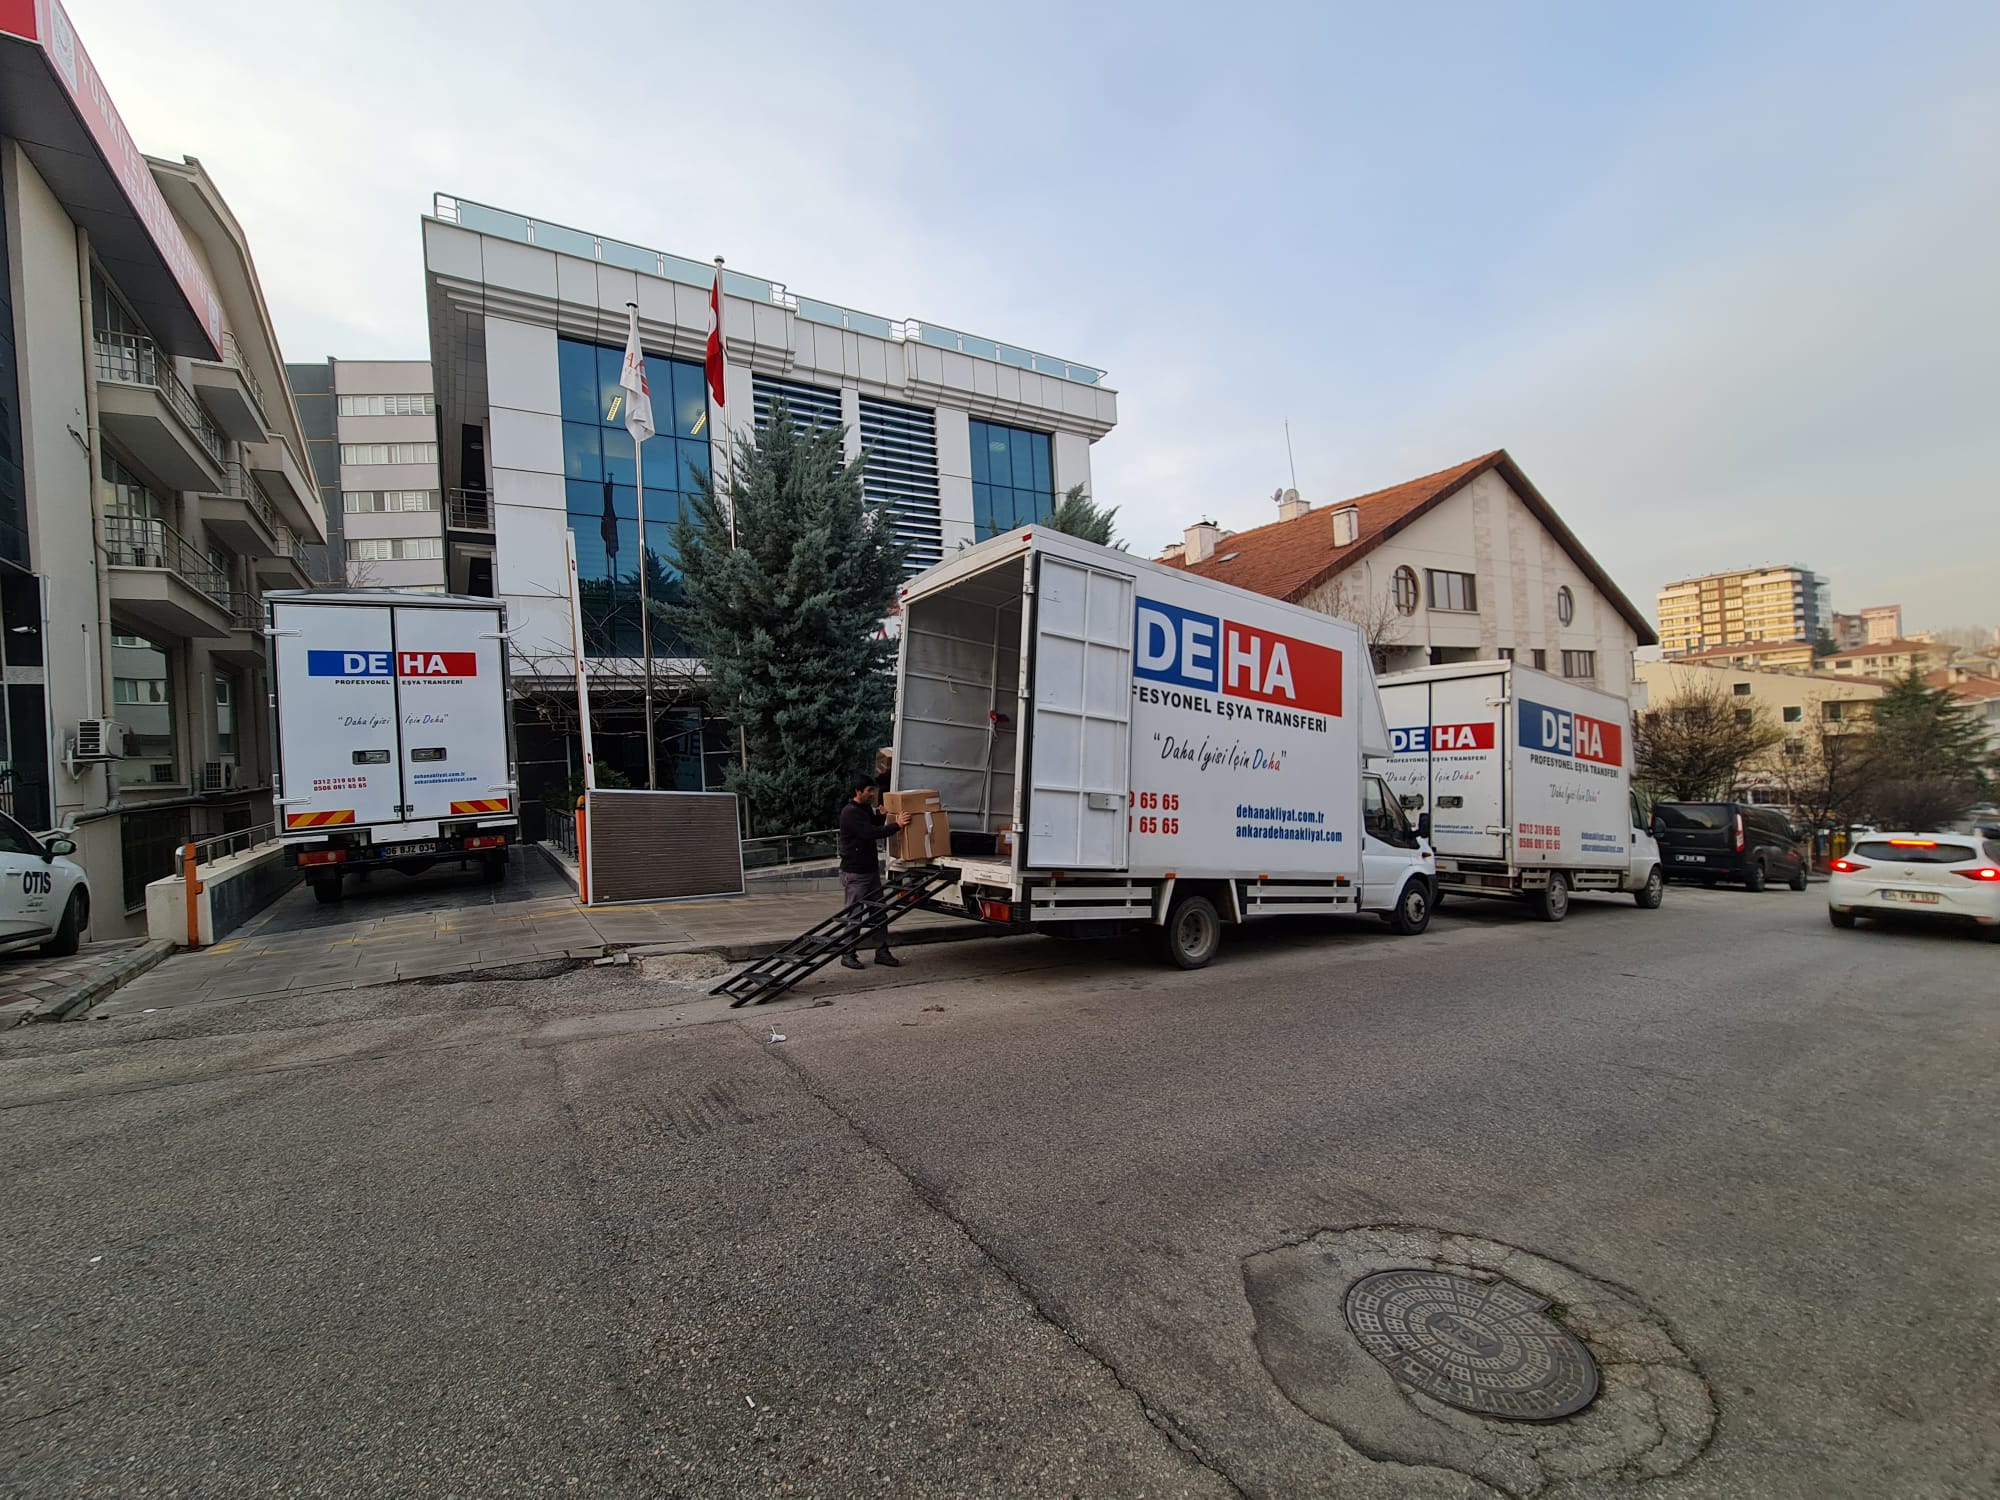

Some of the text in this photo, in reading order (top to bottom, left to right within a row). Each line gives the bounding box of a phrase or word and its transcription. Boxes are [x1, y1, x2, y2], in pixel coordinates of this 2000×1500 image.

[1137, 607, 1296, 700] DEHA
[1217, 700, 1253, 720] EŞYA
[1257, 708, 1327, 733] TRANSFERİ
[1542, 710, 1604, 759] DEHA
[1197, 734, 1226, 771] İyisi
[1228, 739, 1250, 771] İçin
[1530, 754, 1573, 770] PROFESYONEL
[1140, 792, 1157, 809] 65
[1162, 793, 1179, 811] 65
[1236, 804, 1324, 824] dehanakliyat.com.tr
[1140, 816, 1157, 834] 65
[1162, 817, 1179, 835] 65
[1236, 824, 1343, 843] ankaradehanakliyat.com
[23, 870, 51, 894] OTIS
